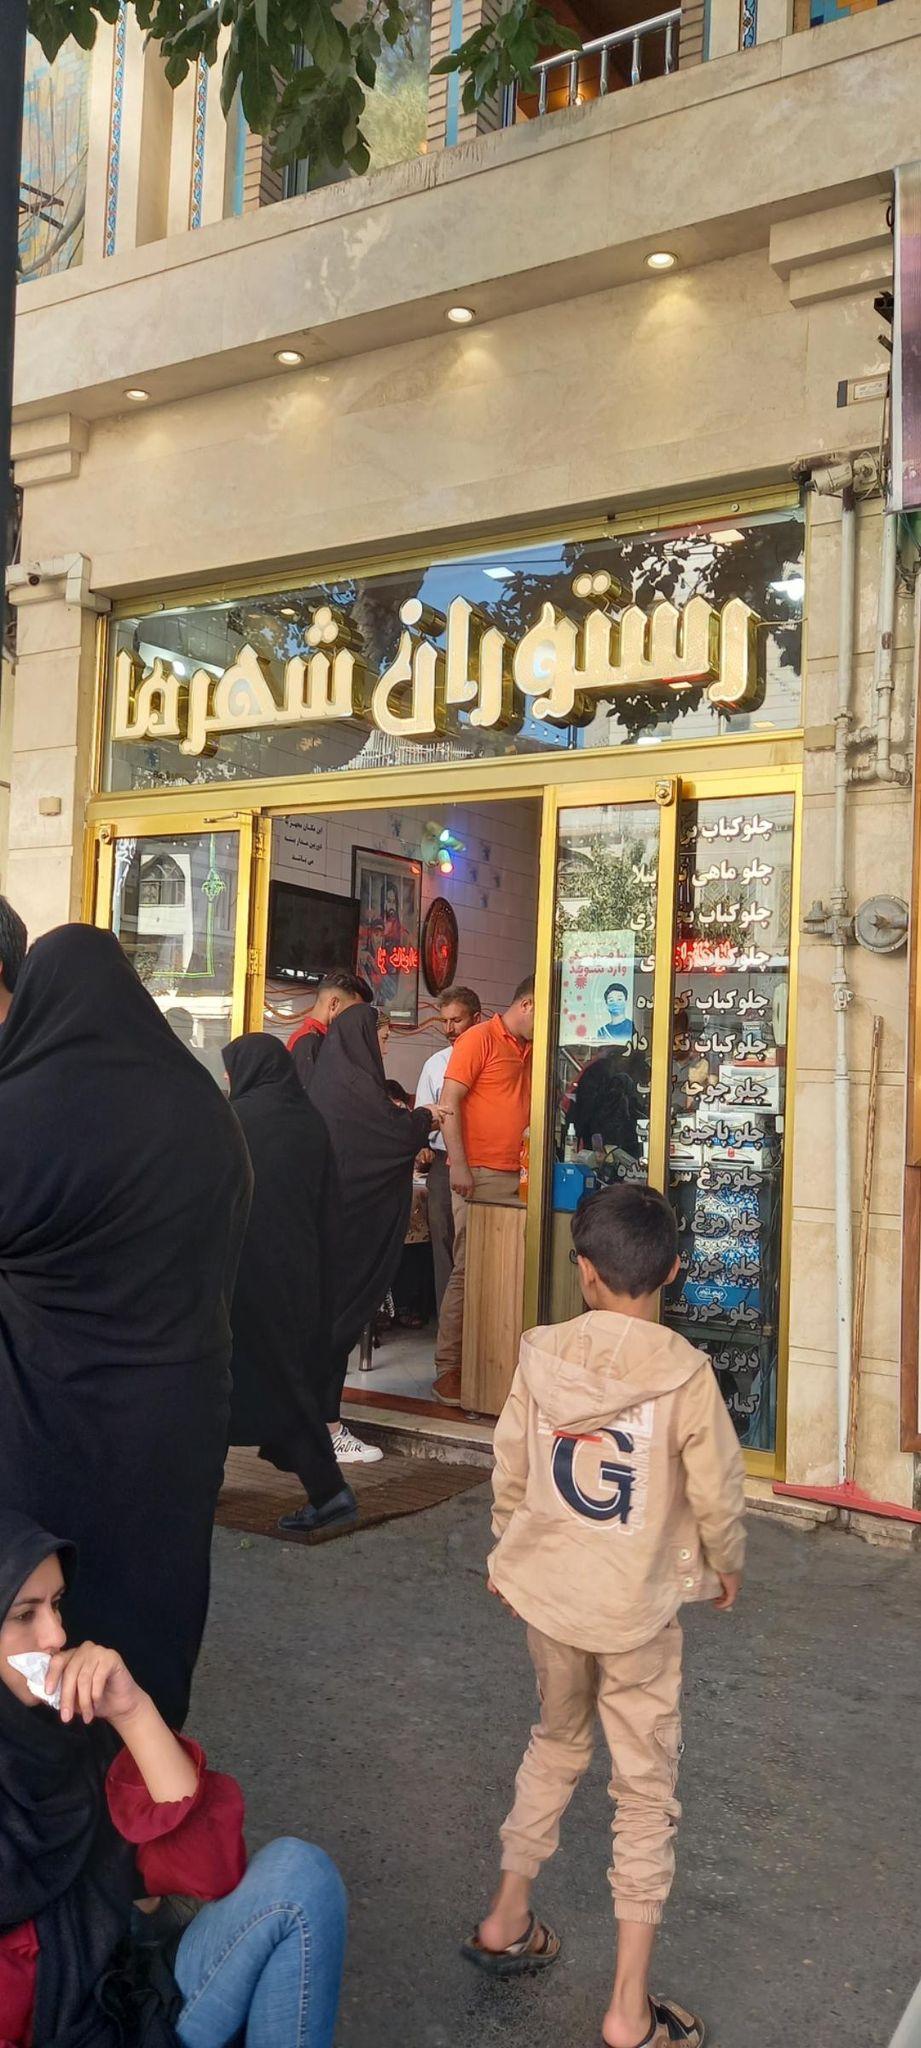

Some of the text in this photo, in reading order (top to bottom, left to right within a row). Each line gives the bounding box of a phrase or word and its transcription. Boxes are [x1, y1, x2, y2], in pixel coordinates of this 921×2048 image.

[372, 571, 758, 737] رستوران
[701, 816, 744, 843] کباب
[741, 813, 775, 843] چلو
[691, 859, 736, 888] ماهی
[741, 857, 774, 885] چلو
[698, 903, 740, 928] کباب
[739, 901, 772, 929] چلو
[606, 963, 628, 977] وارد
[737, 945, 771, 973] چلو
[696, 989, 738, 1015] کباب
[736, 989, 770, 1017] چلو
[694, 1032, 737, 1058] کباب
[735, 1032, 769, 1060] چلو
[681, 1081, 731, 1103] جوجه
[733, 1077, 768, 1104] چلو
[679, 1119, 730, 1148] پاچین
[732, 1120, 765, 1151] چلو
[690, 1204, 726, 1235] مرغ
[729, 1210, 763, 1240] چلو
[728, 1256, 761, 1286] چلو
[726, 1301, 761, 1330] چلو
[713, 1349, 760, 1372] دیزی
[551, 1427, 636, 1528] G
